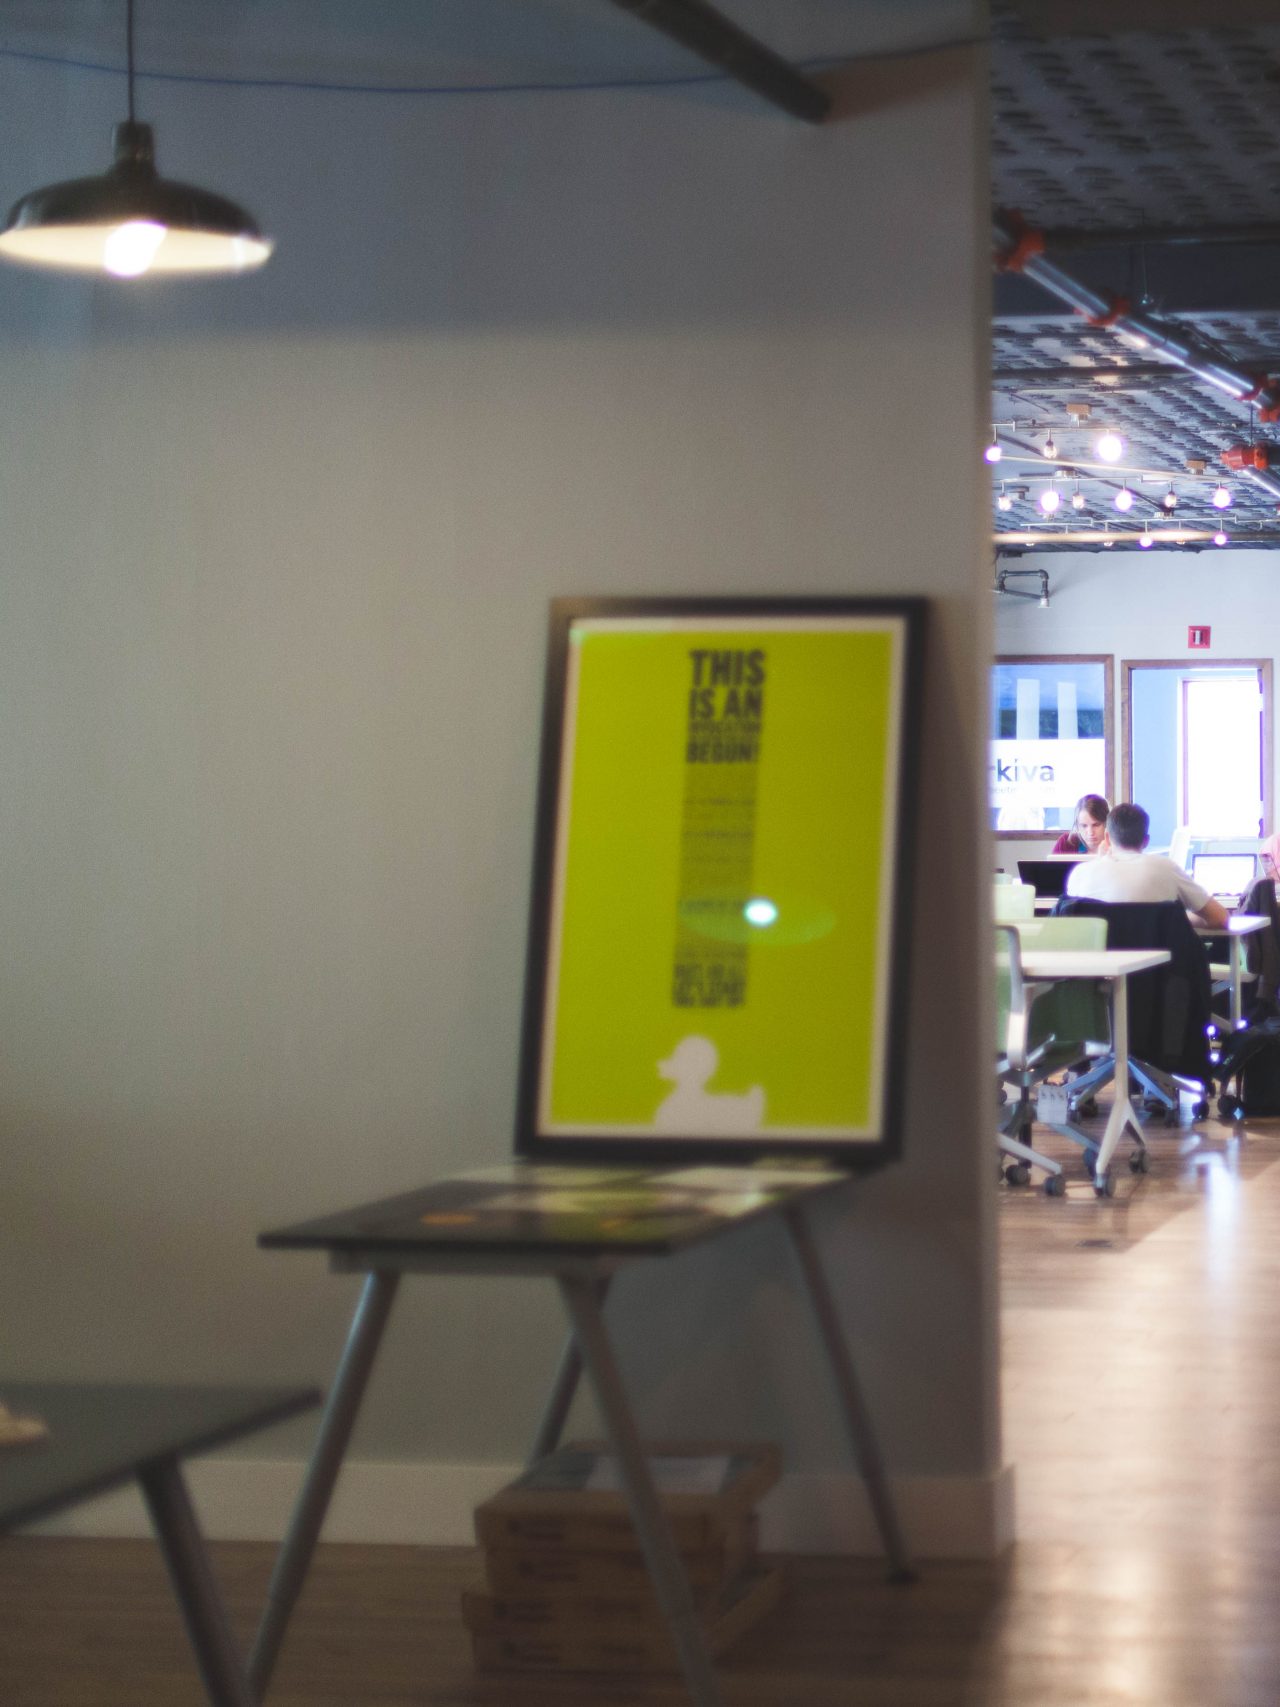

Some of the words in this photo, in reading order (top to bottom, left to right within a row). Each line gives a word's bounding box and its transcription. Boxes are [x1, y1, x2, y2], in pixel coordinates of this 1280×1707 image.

[689, 649, 766, 686] THIS
[689, 688, 715, 719] IS
[723, 688, 762, 718] AN
